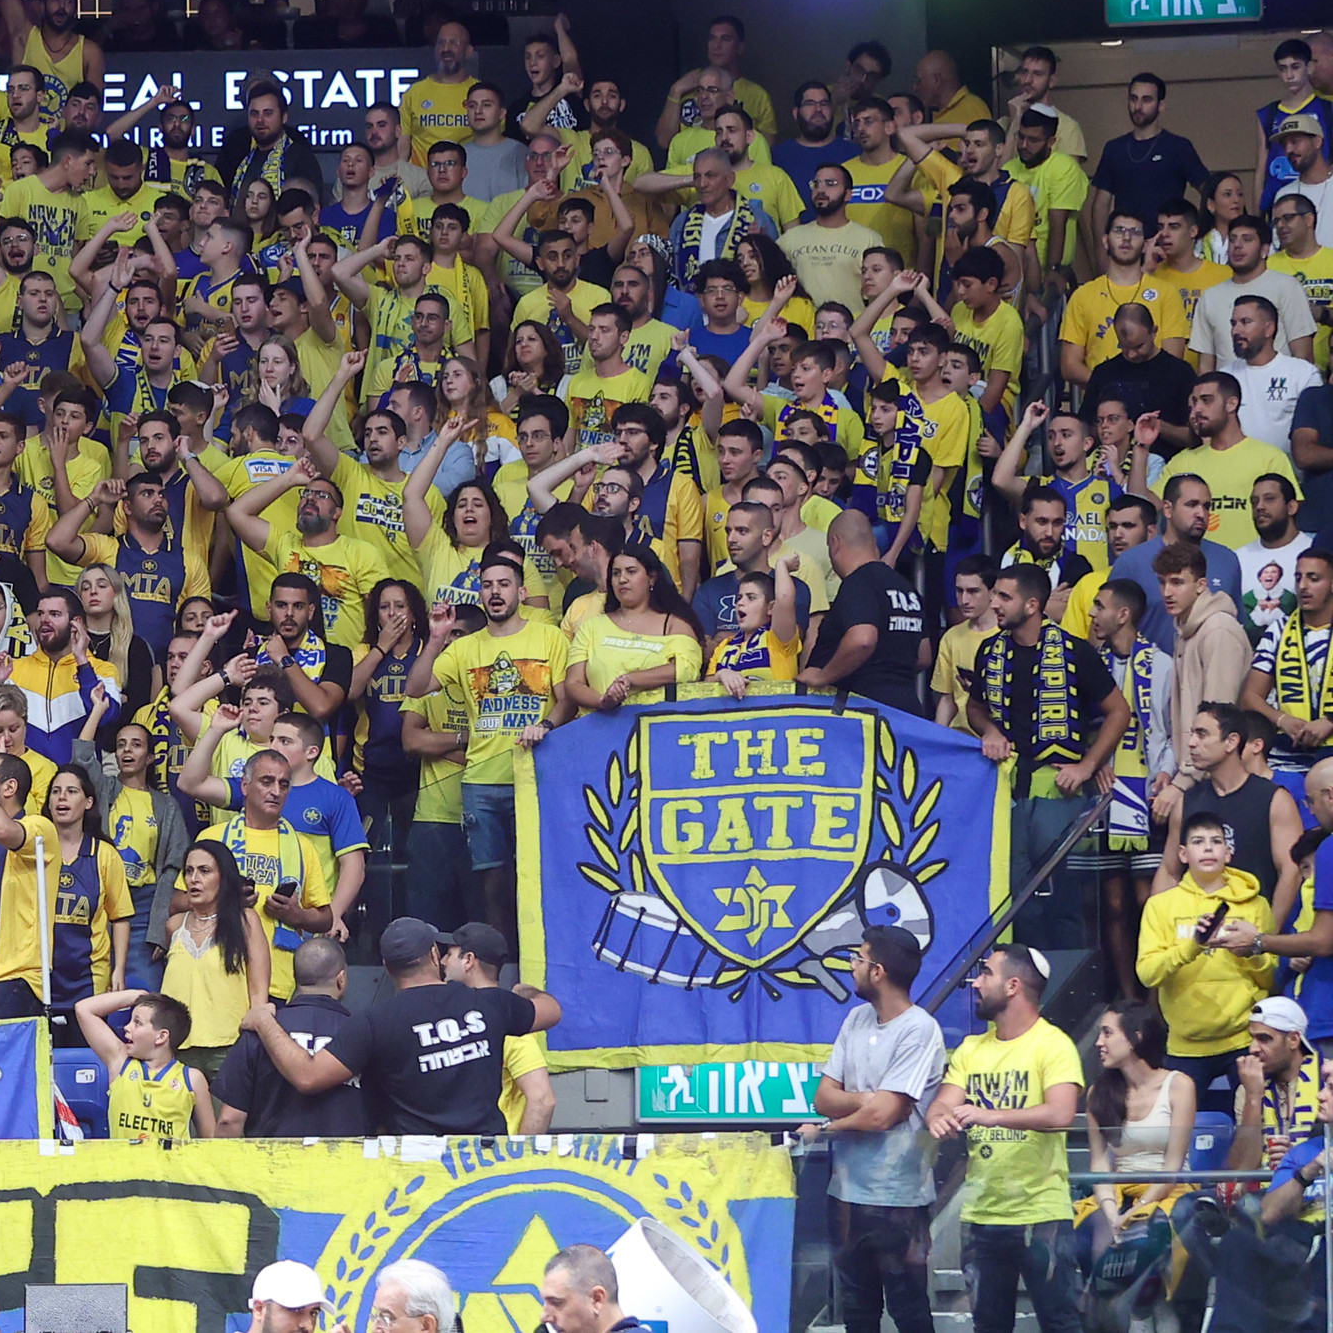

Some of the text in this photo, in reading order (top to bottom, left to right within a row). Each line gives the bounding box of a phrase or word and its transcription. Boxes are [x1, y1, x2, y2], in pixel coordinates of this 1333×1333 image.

[828, 243, 860, 259] CLUB
[122, 569, 172, 601] MTA
[677, 726, 826, 782] THE
[660, 796, 858, 855] GATE
[118, 1111, 174, 1136] ELECTRA
